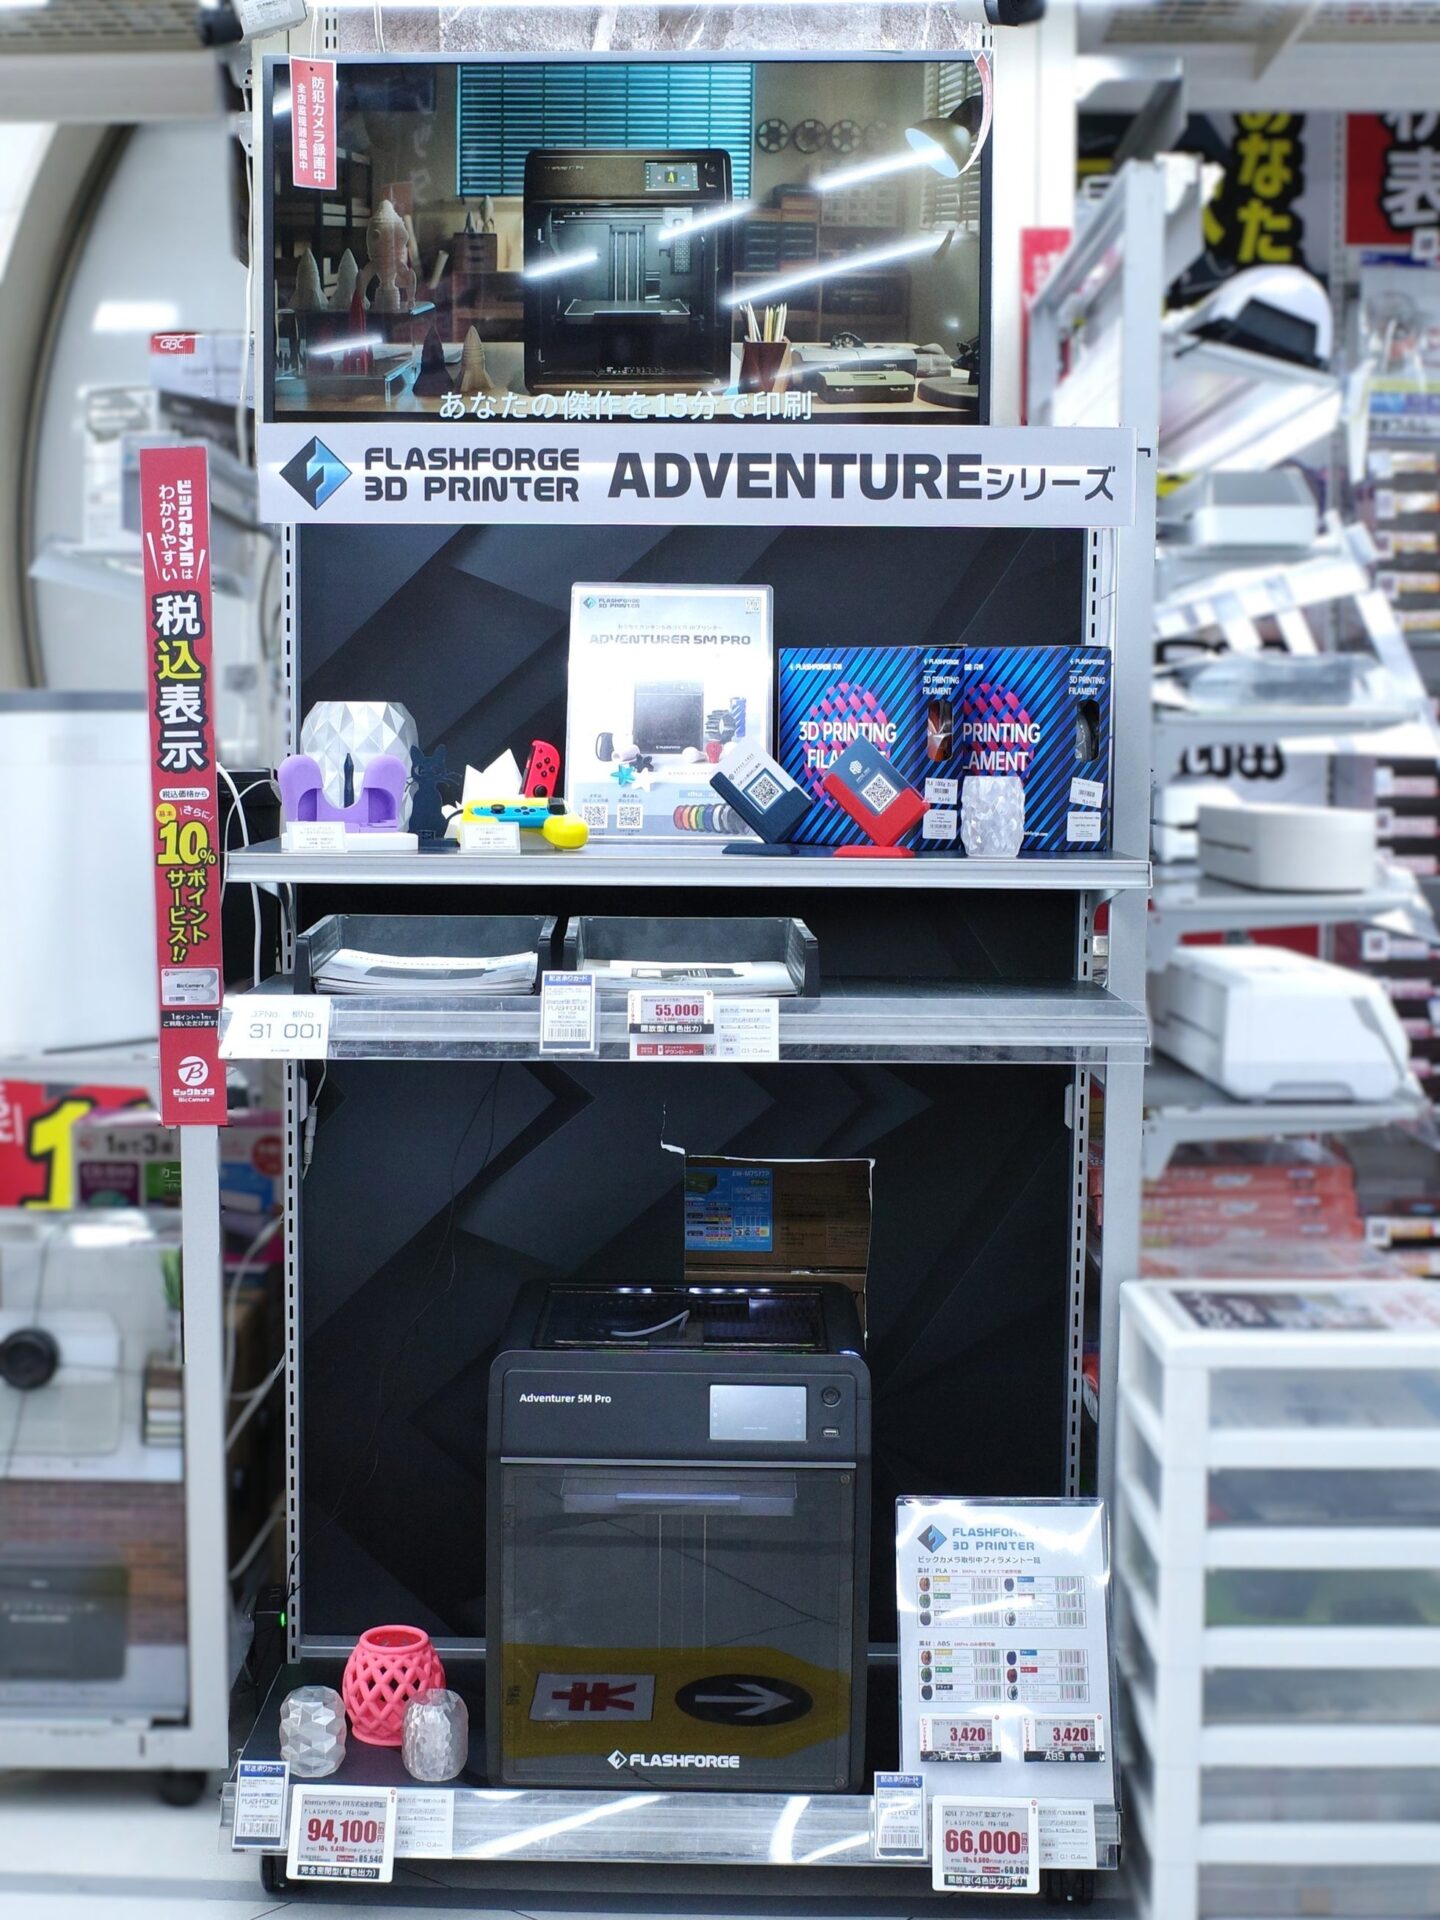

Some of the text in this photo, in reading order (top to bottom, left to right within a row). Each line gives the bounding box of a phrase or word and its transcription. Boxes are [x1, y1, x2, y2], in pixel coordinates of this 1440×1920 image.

[312, 76, 326, 183] 防犯カメラ録画中
[159, 337, 187, 350] GBC
[439, 390, 813, 420] あなたの傑作を15分で印刷
[364, 447, 580, 472] FLASHFORGE
[364, 476, 579, 502] 3D PRINTER
[159, 484, 178, 582] わかりやすい
[177, 480, 194, 580] ビックカメラは
[590, 634, 690, 645] ADVENTURER
[720, 635, 751, 645] PRO
[156, 594, 204, 769] 税込表示
[922, 687, 952, 695] FILAMENT
[1069, 687, 1098, 695] FILAMENT
[799, 721, 897, 743] 3D PRINTING
[963, 722, 1041, 744] PRINTING
[162, 789, 208, 799] 税込価格から
[182, 805, 211, 821] さらに
[157, 821, 216, 865] 10%
[187, 868, 208, 944] ポイント
[655, 1004, 699, 1016] 55,000
[249, 1023, 322, 1039] 31 001
[519, 1393, 612, 1404] Adventurer 5M Pro
[953, 1541, 1035, 1551] 3D PRINTER
[950, 1727, 986, 1742] 3,420
[1053, 1727, 1089, 1742] 3,420
[629, 1753, 740, 1768] FLASHFORGE
[1044, 1752, 1065, 1761] ABS
[307, 1818, 378, 1844] 94,100
[945, 1829, 1021, 1855] 66,000
